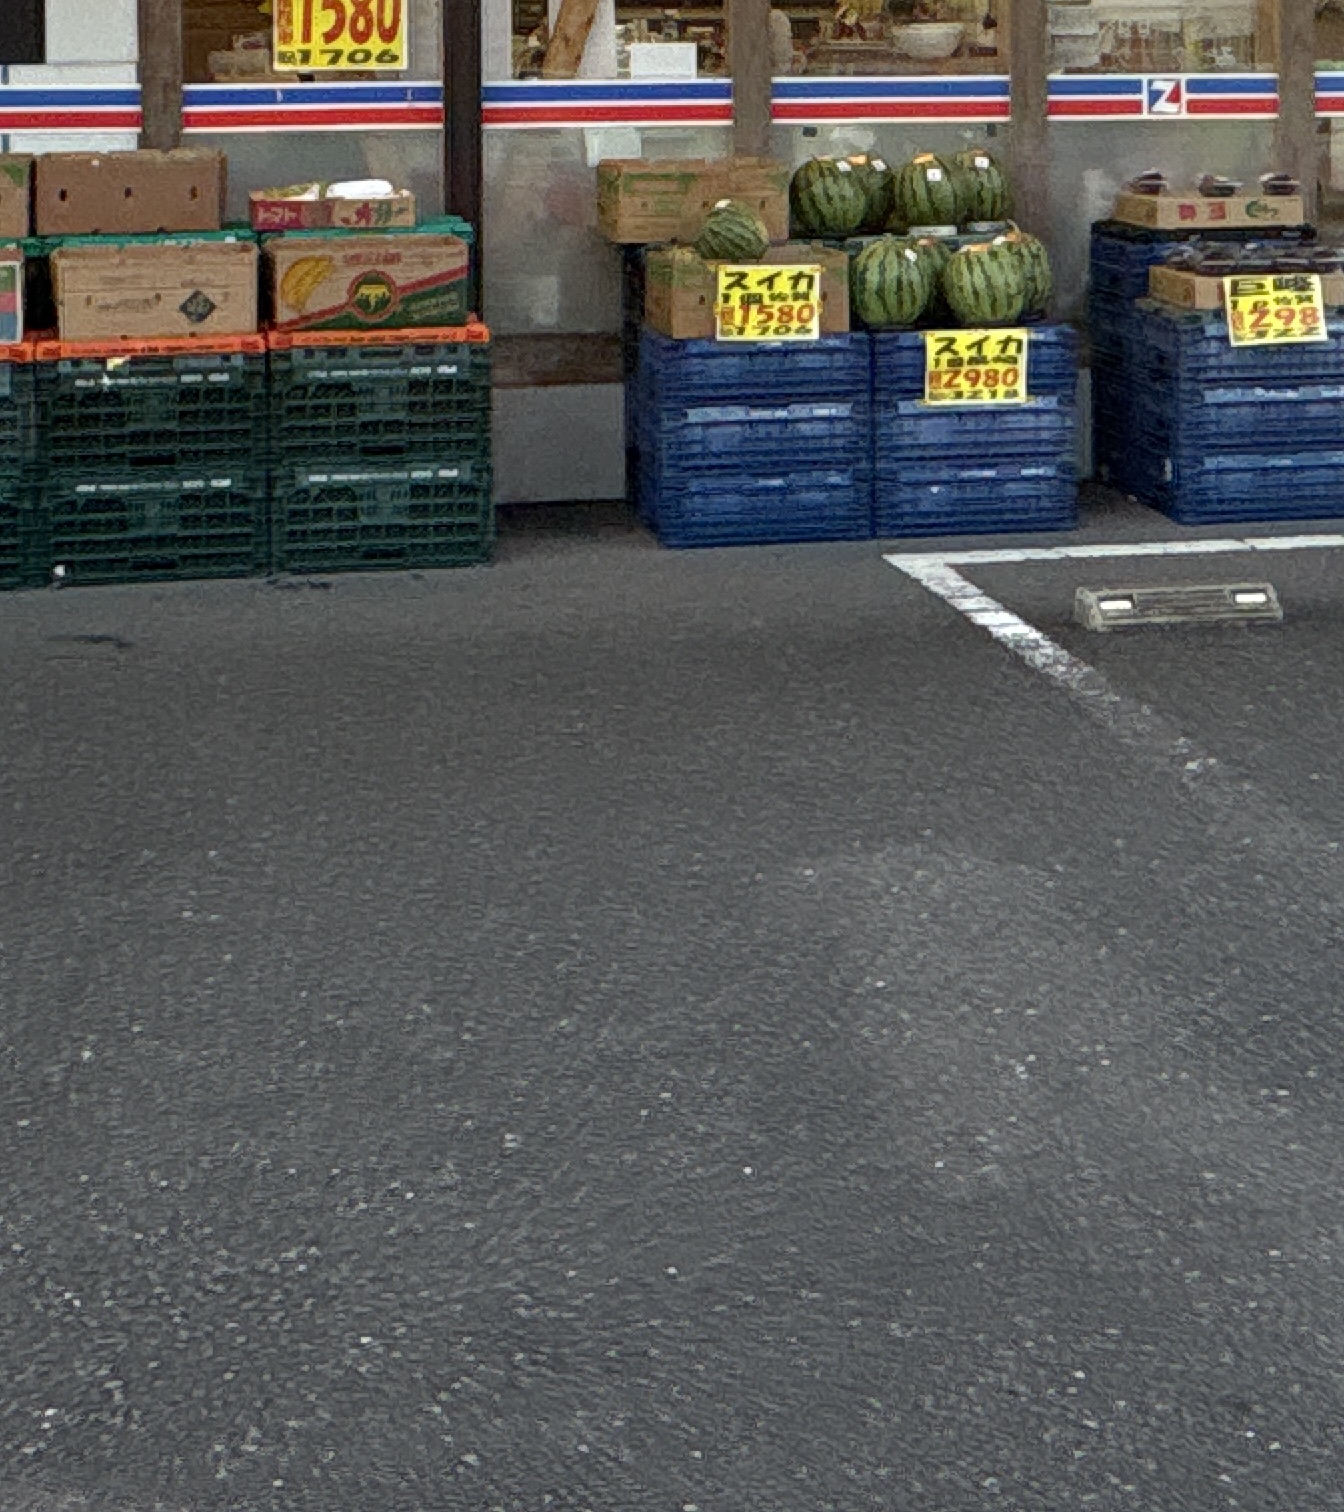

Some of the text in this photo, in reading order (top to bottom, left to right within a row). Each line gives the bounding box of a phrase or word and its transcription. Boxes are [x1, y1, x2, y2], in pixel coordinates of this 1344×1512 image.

[297, 49, 399, 64] 1706
[259, 207, 297, 223] トマト
[725, 271, 814, 290] スイカ
[740, 304, 815, 324] 1580
[1248, 307, 1319, 329] 298
[935, 335, 1023, 355] スイカ
[943, 368, 1018, 388] 2980
